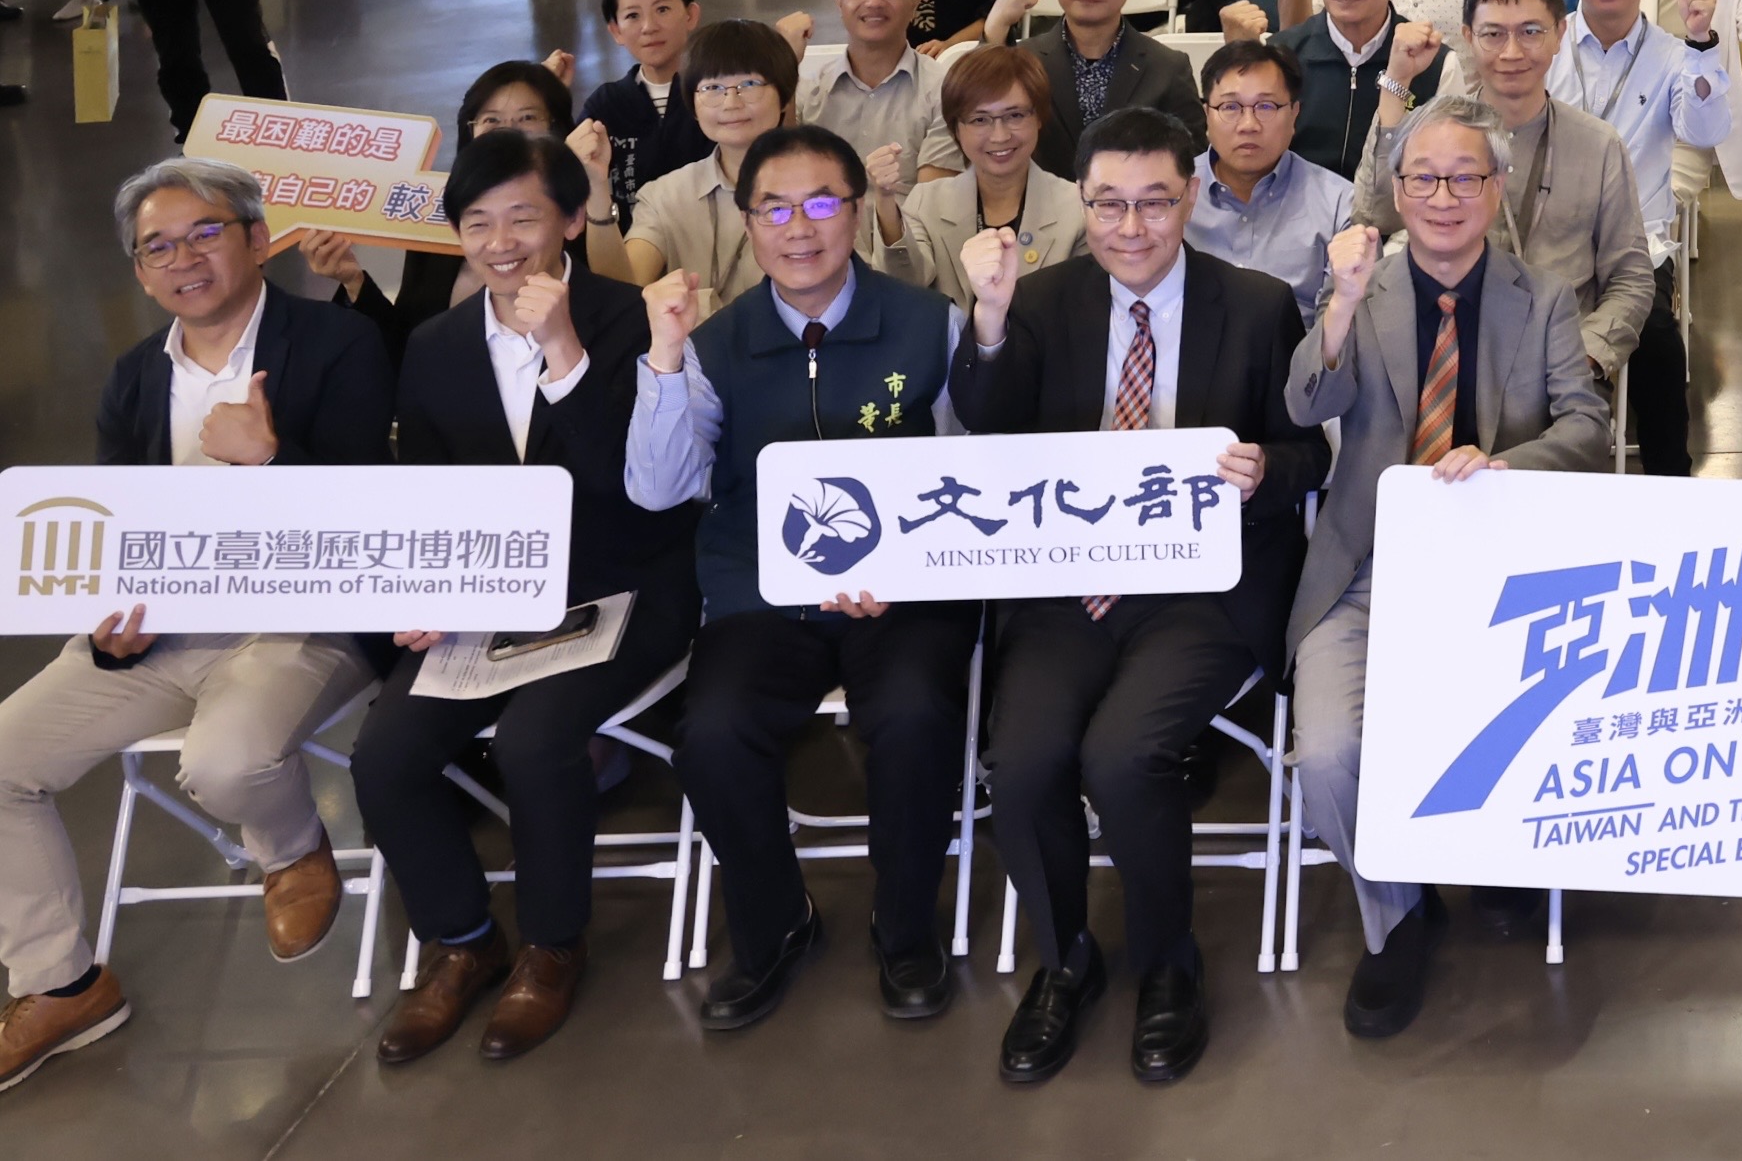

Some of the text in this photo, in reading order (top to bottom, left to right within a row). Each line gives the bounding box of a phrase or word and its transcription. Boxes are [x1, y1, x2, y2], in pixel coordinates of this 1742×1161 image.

[217, 109, 402, 161] 最困難的是
[884, 371, 907, 428] 市長
[898, 464, 1227, 536] 文化部
[118, 530, 550, 571] 國立臺灣歷史博物館
[925, 543, 1201, 567] MINISTRY OF CULTURE
[116, 574, 547, 598] National Museum of Taiwan History
[1533, 754, 1642, 802] ASIA
[1664, 740, 1737, 784] ON
[1657, 802, 1720, 833] AND
[1625, 840, 1727, 876] SPECIAL
